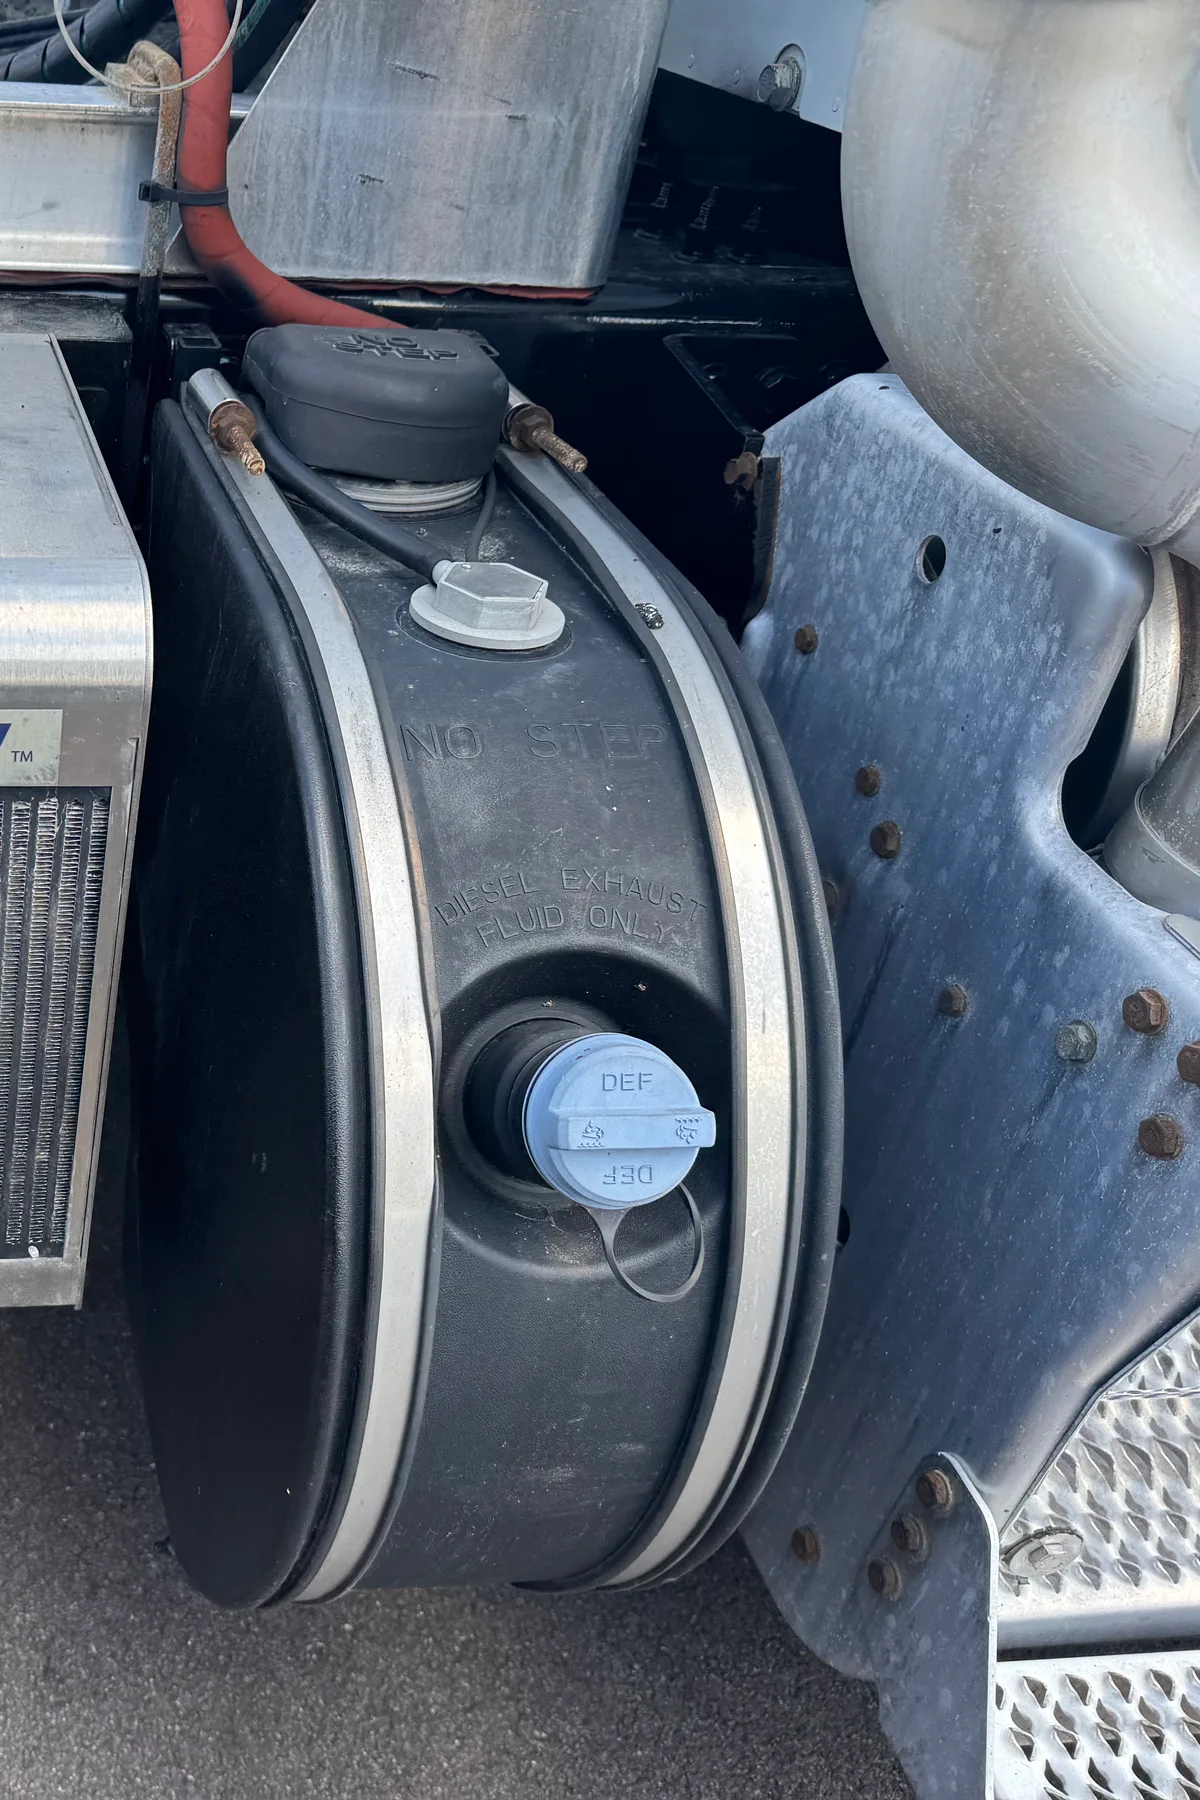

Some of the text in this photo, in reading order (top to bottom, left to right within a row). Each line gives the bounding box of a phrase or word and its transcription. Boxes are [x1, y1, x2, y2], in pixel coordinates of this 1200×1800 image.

[333, 341, 459, 360] STEP
[349, 333, 419, 348] NO
[400, 723, 665, 761] NO STEP
[434, 867, 708, 926] DIESEL EXHAUST
[475, 905, 675, 948] FLUID ONLY
[602, 1072, 653, 1092] DEF
[603, 1164, 653, 1185] DEF
